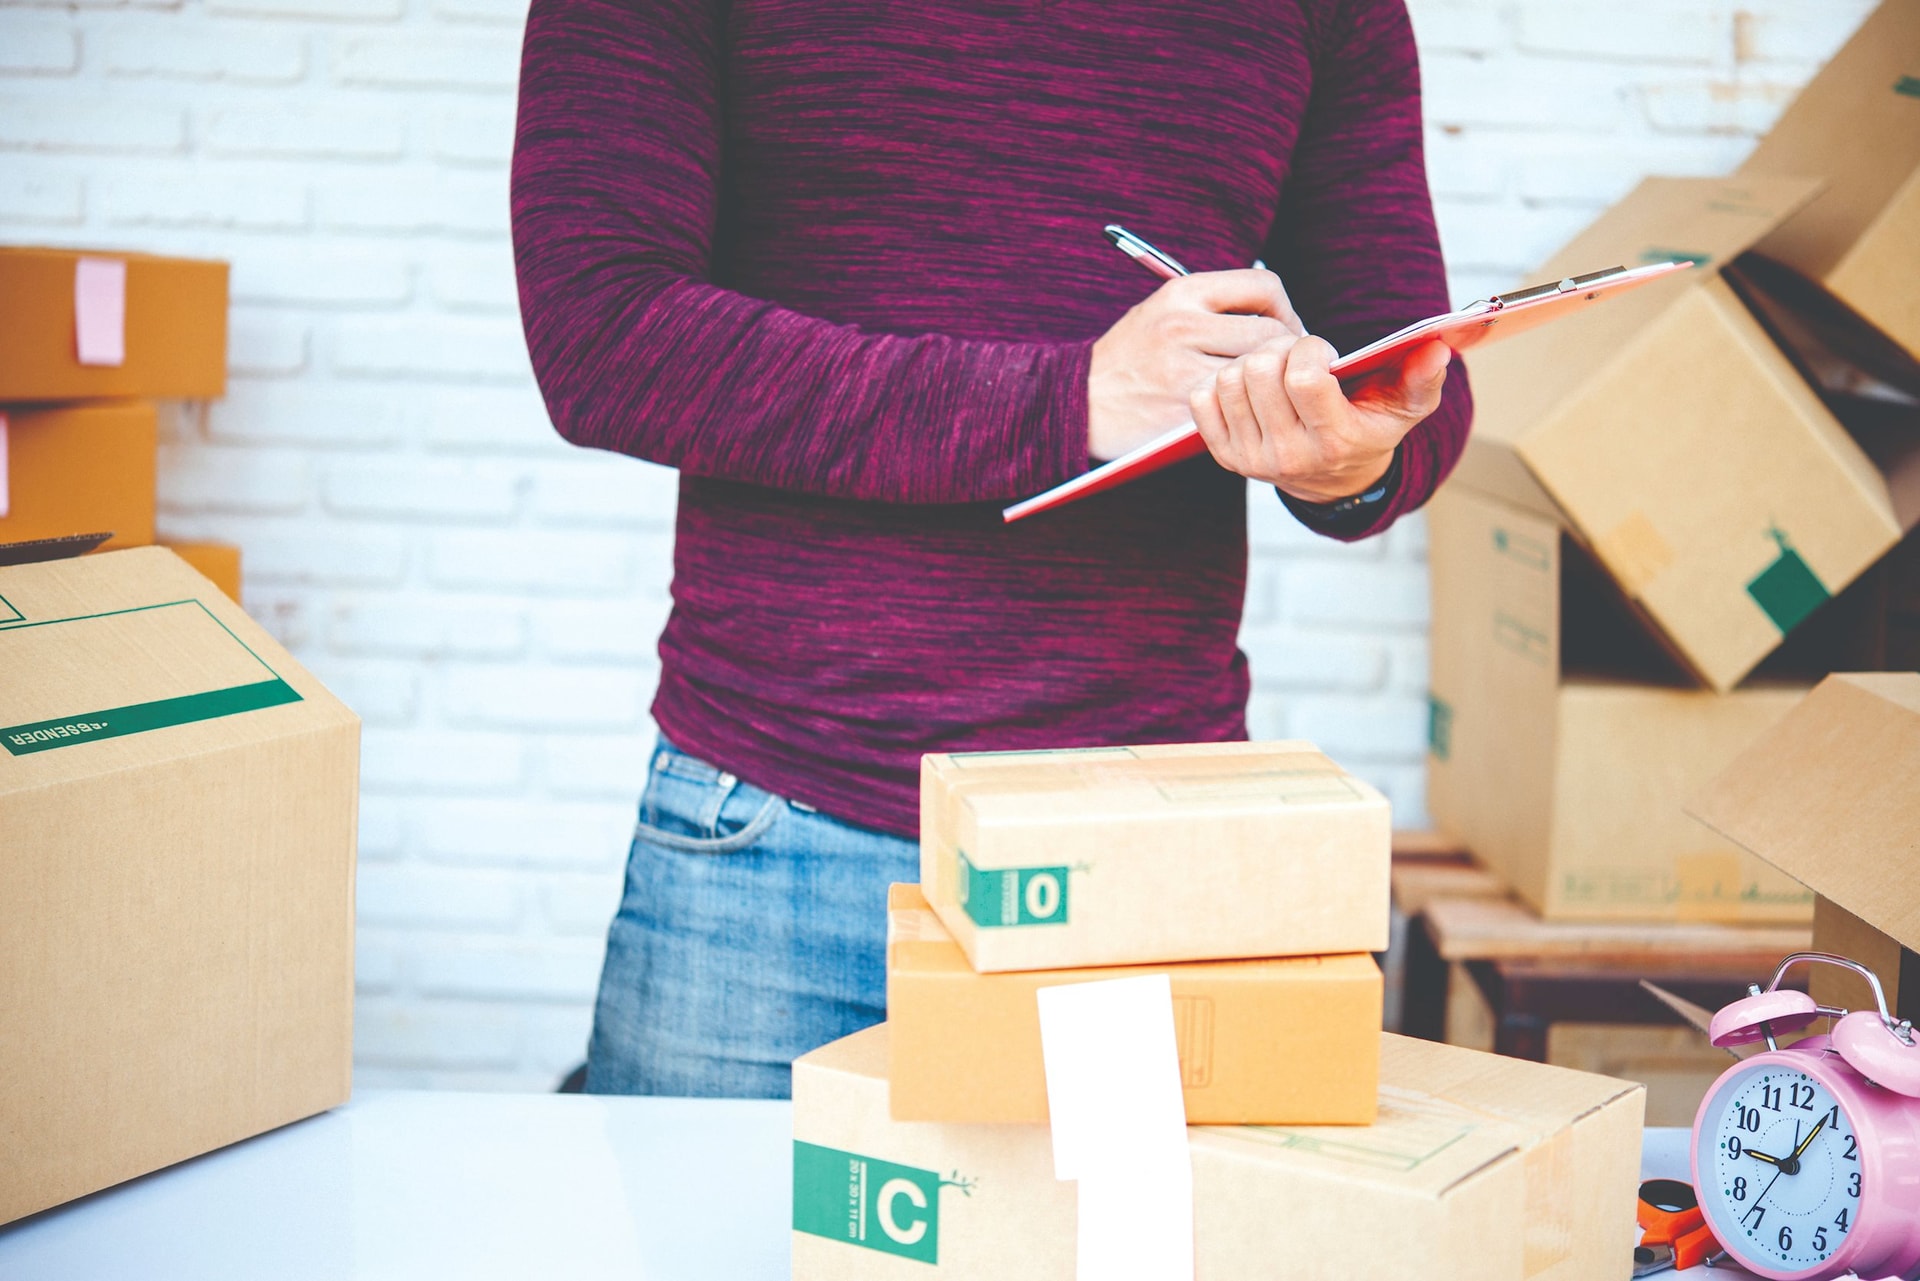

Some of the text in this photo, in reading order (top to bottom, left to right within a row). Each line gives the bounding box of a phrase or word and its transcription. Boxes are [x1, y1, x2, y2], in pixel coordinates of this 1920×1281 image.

[1761, 1084, 1781, 1112] 11
[1789, 1082, 1815, 1111] 12
[1737, 1105, 1760, 1132] 10
[1829, 1105, 1839, 1130] 1
[1728, 1137, 1741, 1160] 9
[1843, 1135, 1856, 1160] 2
[1733, 1176, 1746, 1201] 8
[1848, 1172, 1861, 1197] 3
[877, 1178, 928, 1245] C
[1752, 1206, 1765, 1230] 7
[1834, 1207, 1848, 1233] 4
[1778, 1226, 1792, 1251] 6
[1812, 1228, 1826, 1251] 5
